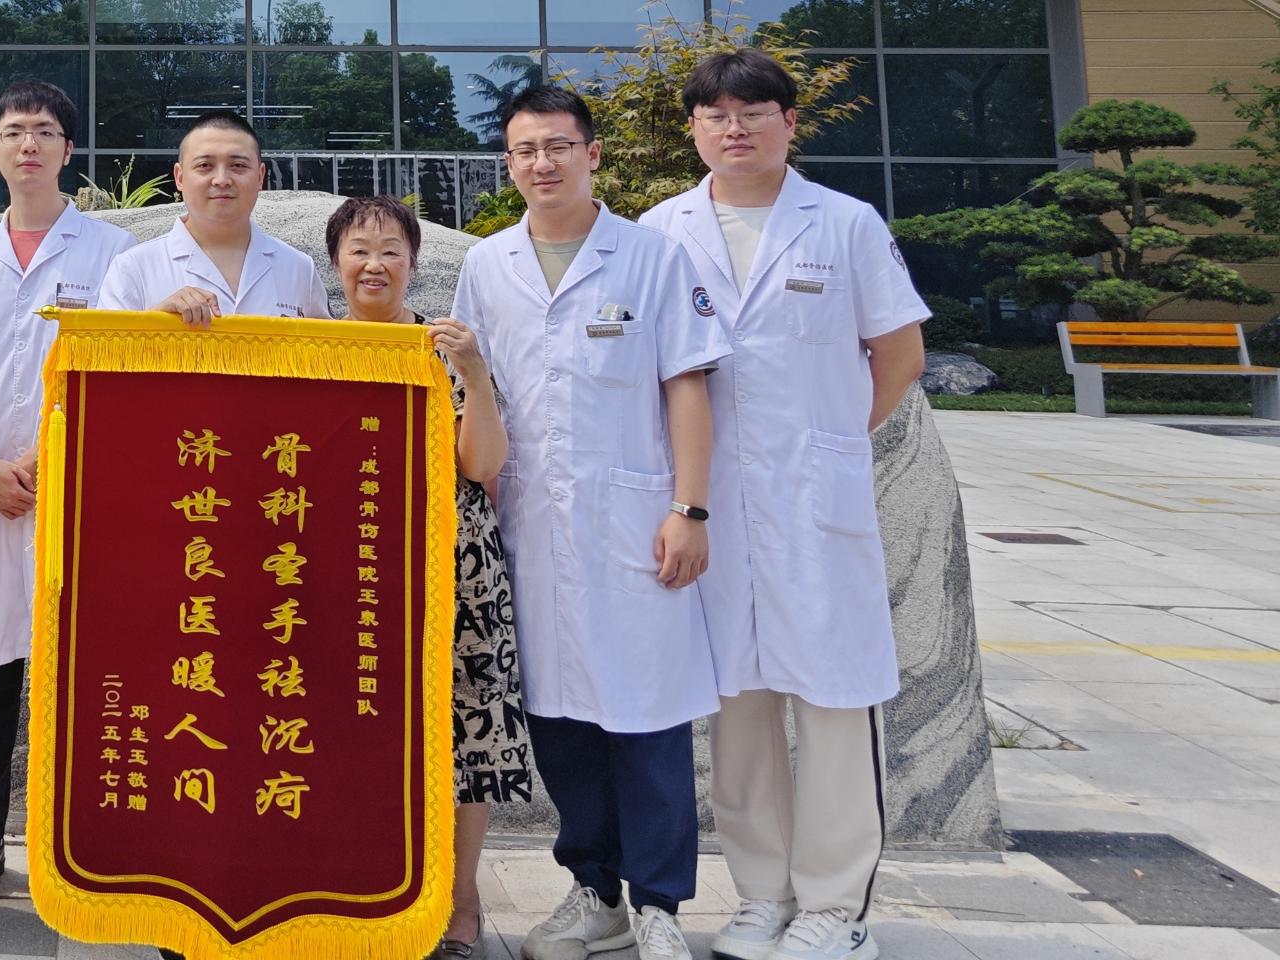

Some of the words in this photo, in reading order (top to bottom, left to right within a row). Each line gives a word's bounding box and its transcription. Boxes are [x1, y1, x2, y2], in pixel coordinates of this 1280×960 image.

[126, 704, 150, 812] 邓生玉敬赠
[163, 428, 233, 816] 济世良医暖人间
[255, 432, 315, 821] 骨科圣手祛沉疴
